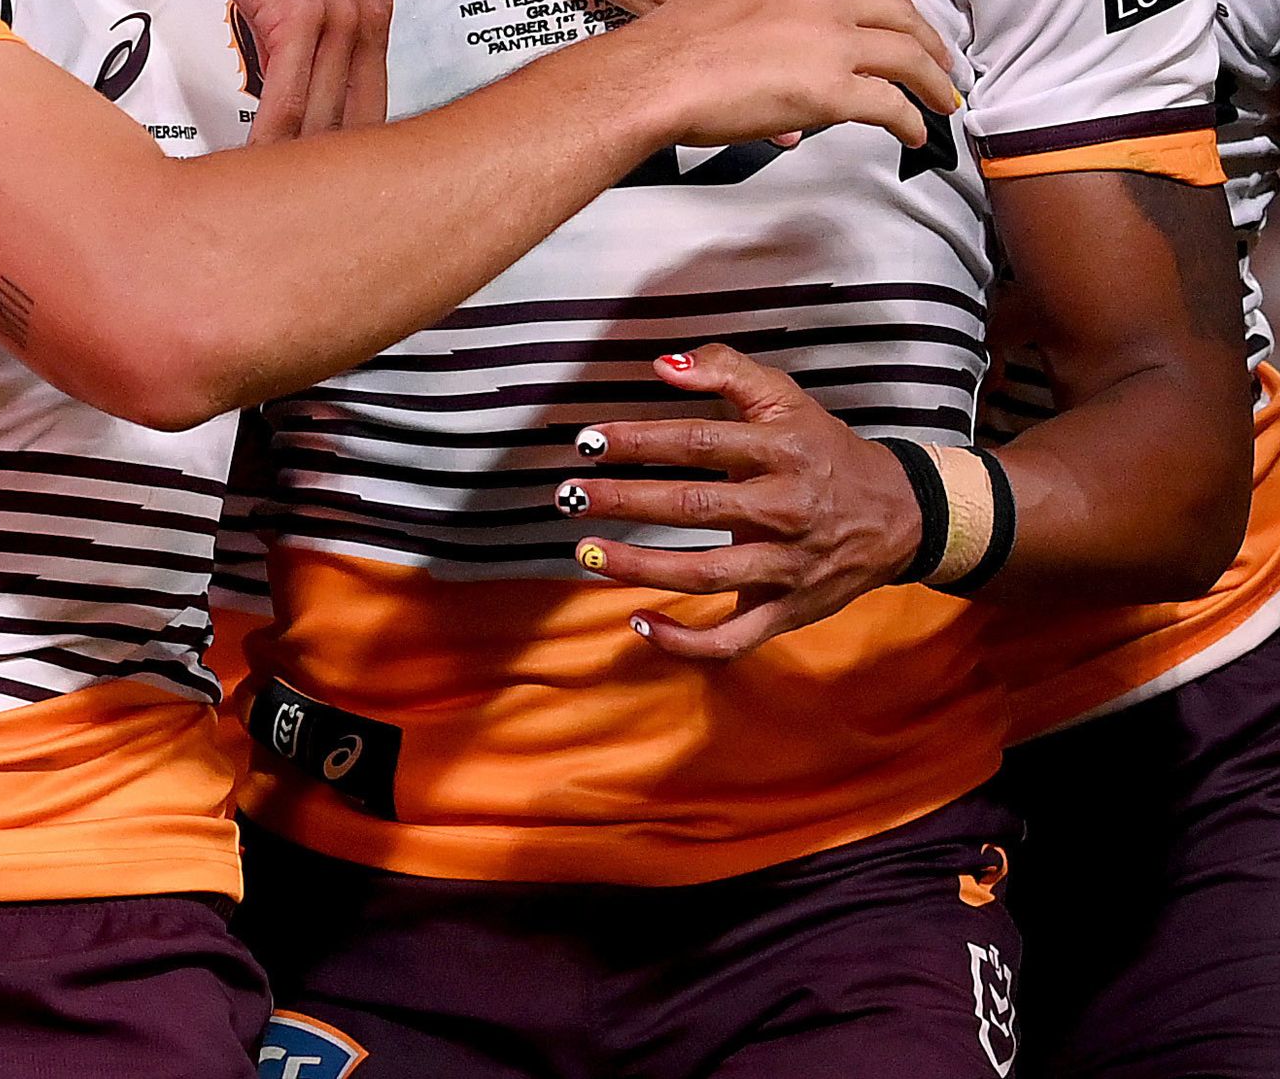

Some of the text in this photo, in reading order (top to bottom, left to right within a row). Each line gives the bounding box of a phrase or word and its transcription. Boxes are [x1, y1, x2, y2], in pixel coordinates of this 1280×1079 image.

[459, 0, 496, 18] NRL
[467, 19, 550, 45] OCTOBER
[488, 28, 578, 54] PANTHERS
